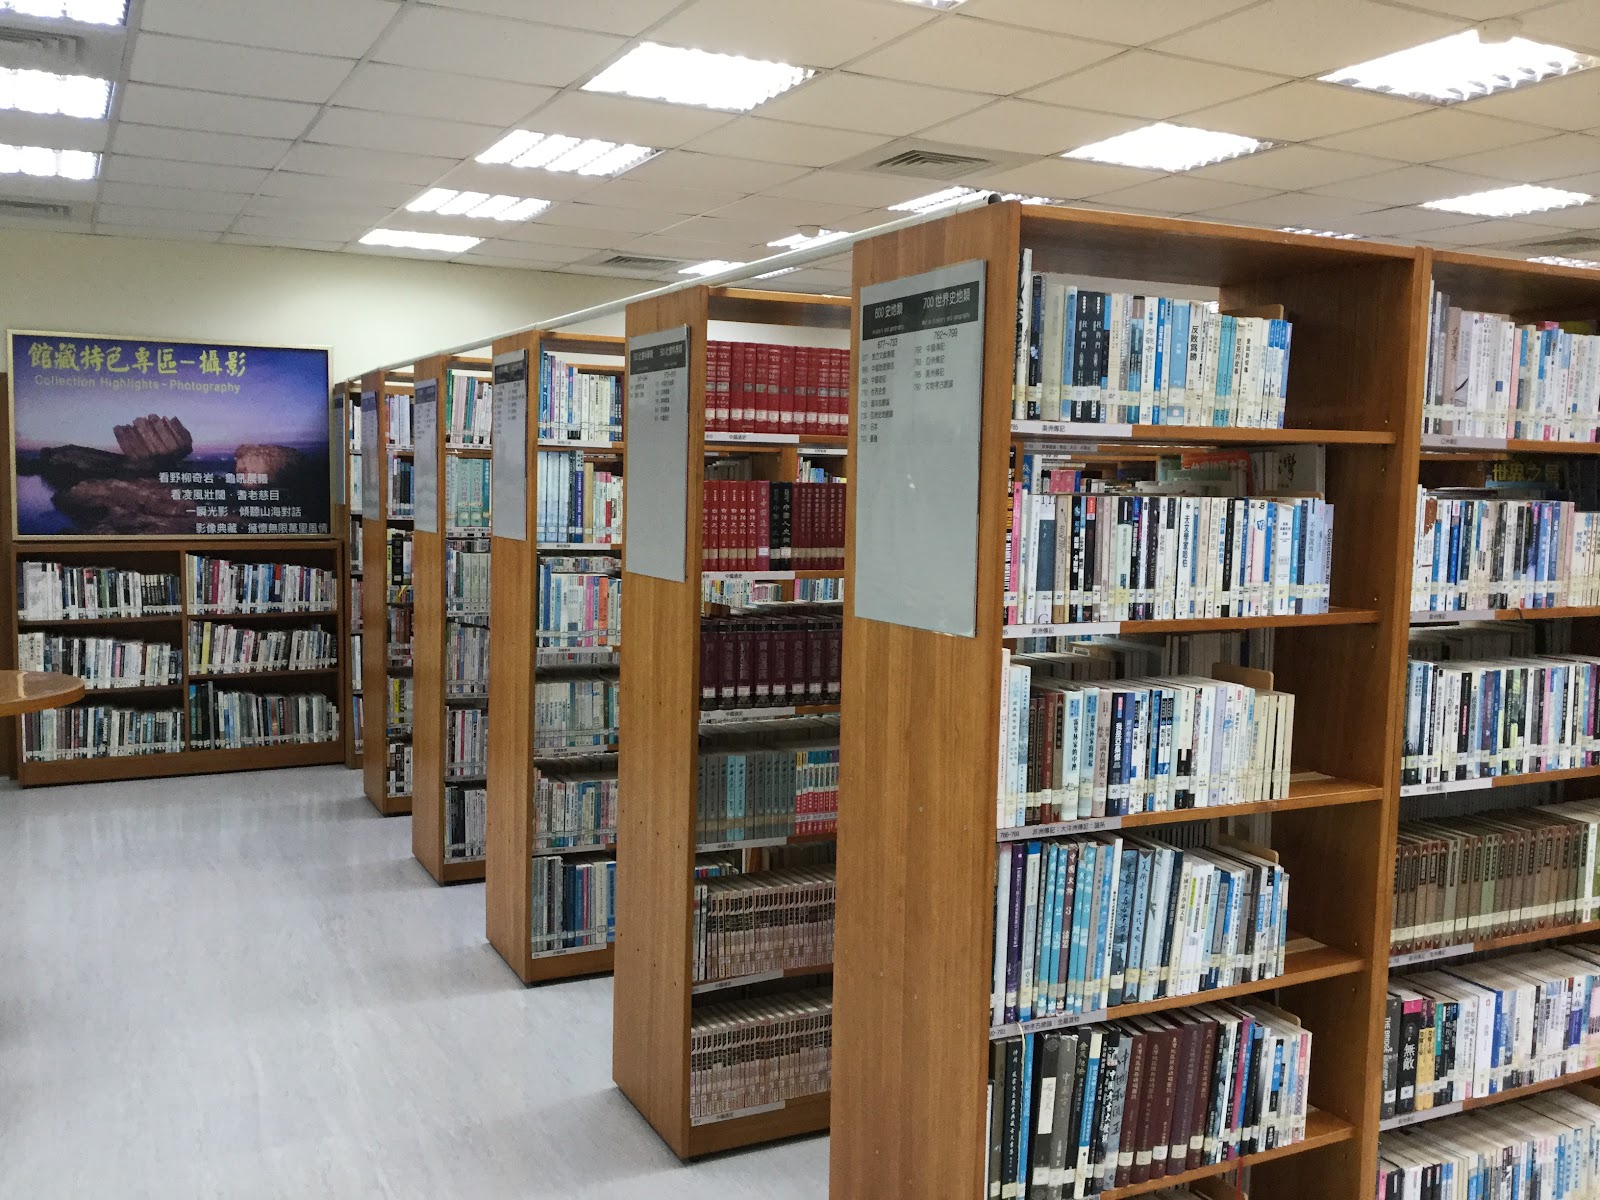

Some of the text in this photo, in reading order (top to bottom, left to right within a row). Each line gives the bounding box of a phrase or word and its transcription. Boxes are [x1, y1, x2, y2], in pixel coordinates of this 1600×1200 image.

[936, 288, 970, 307] 世界史地類
[885, 302, 903, 318] 史地類
[34, 374, 95, 387] Collection
[100, 376, 160, 390] Highlights
[170, 380, 240, 394] Photography
[1066, 852, 1076, 896] 中國文物
[1402, 1044, 1415, 1070] 無敵
